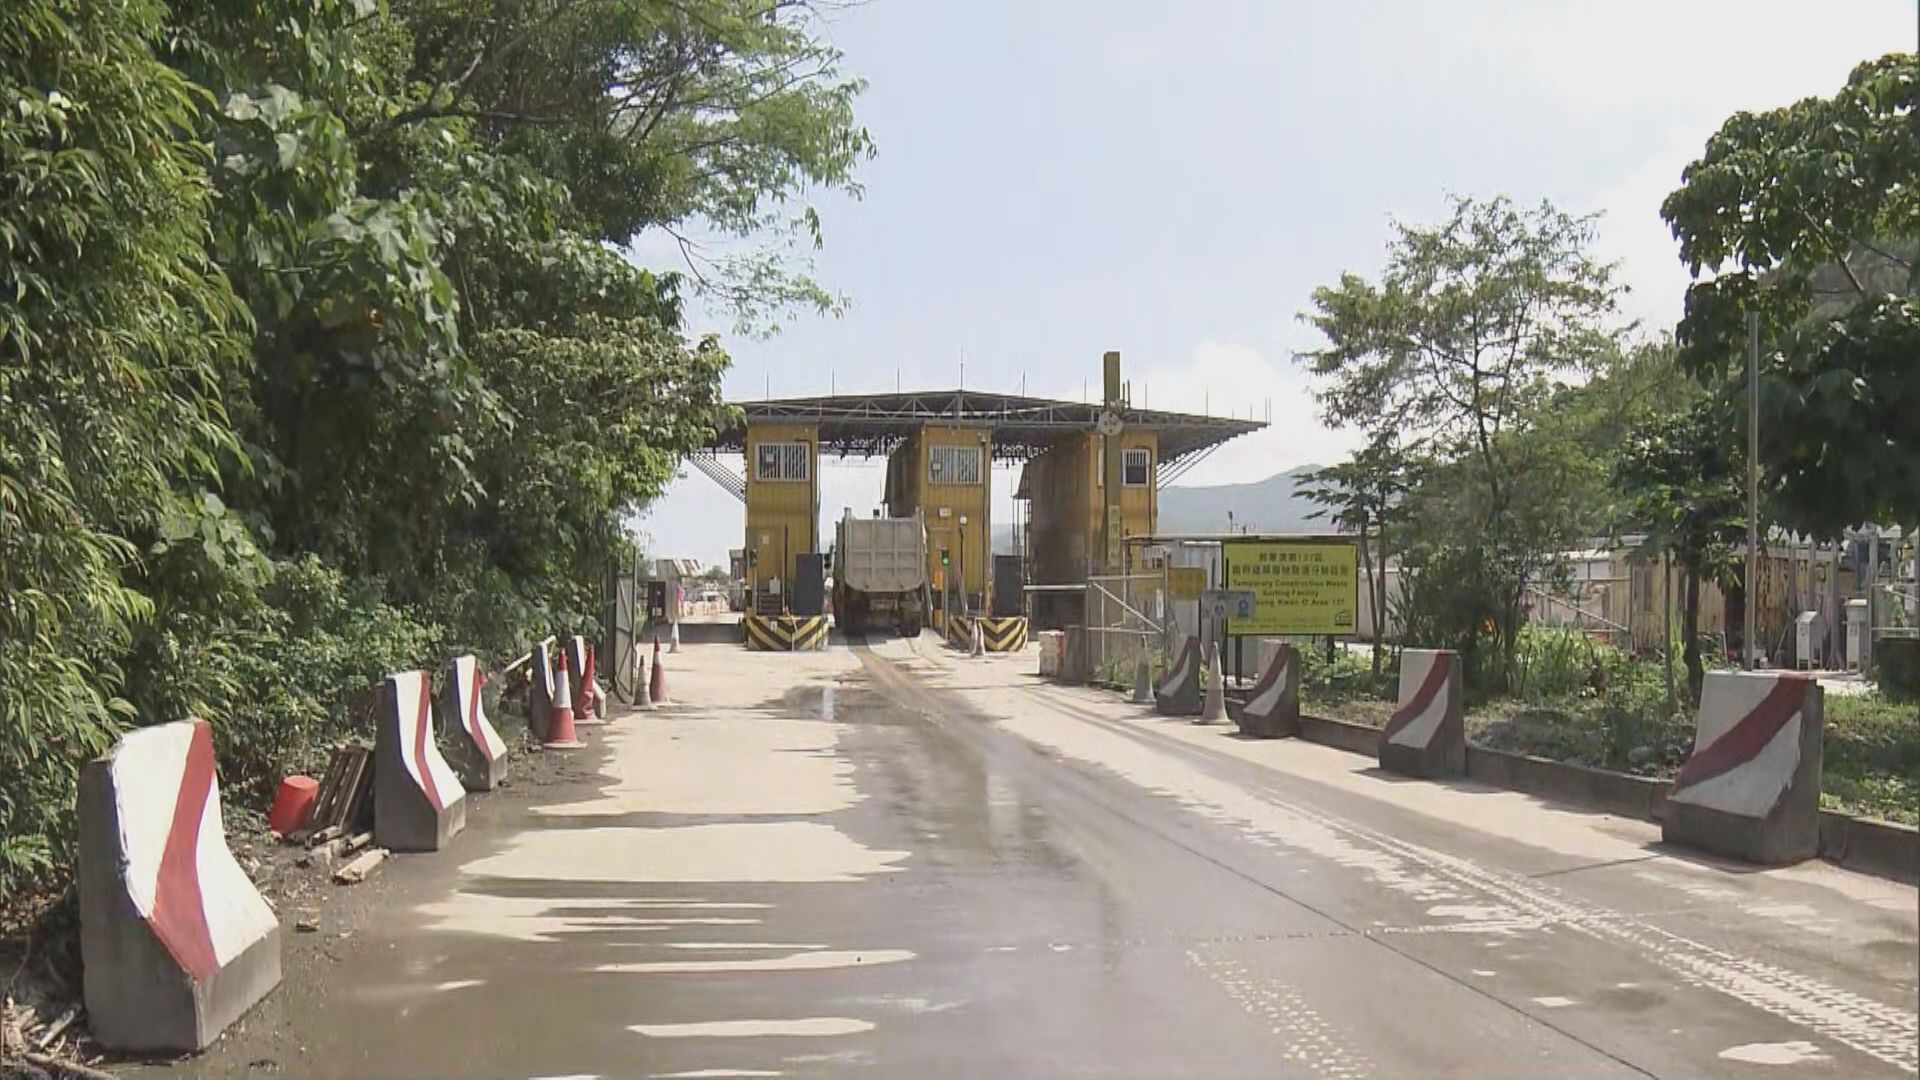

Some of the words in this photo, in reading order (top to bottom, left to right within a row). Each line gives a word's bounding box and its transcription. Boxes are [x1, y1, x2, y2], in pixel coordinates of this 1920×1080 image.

[1233, 579, 1273, 588] Temporary
[1275, 579, 1324, 587] Construction
[1262, 589, 1290, 598] Sorting
[1291, 589, 1319, 598] Facility
[1311, 598, 1329, 606] Area
